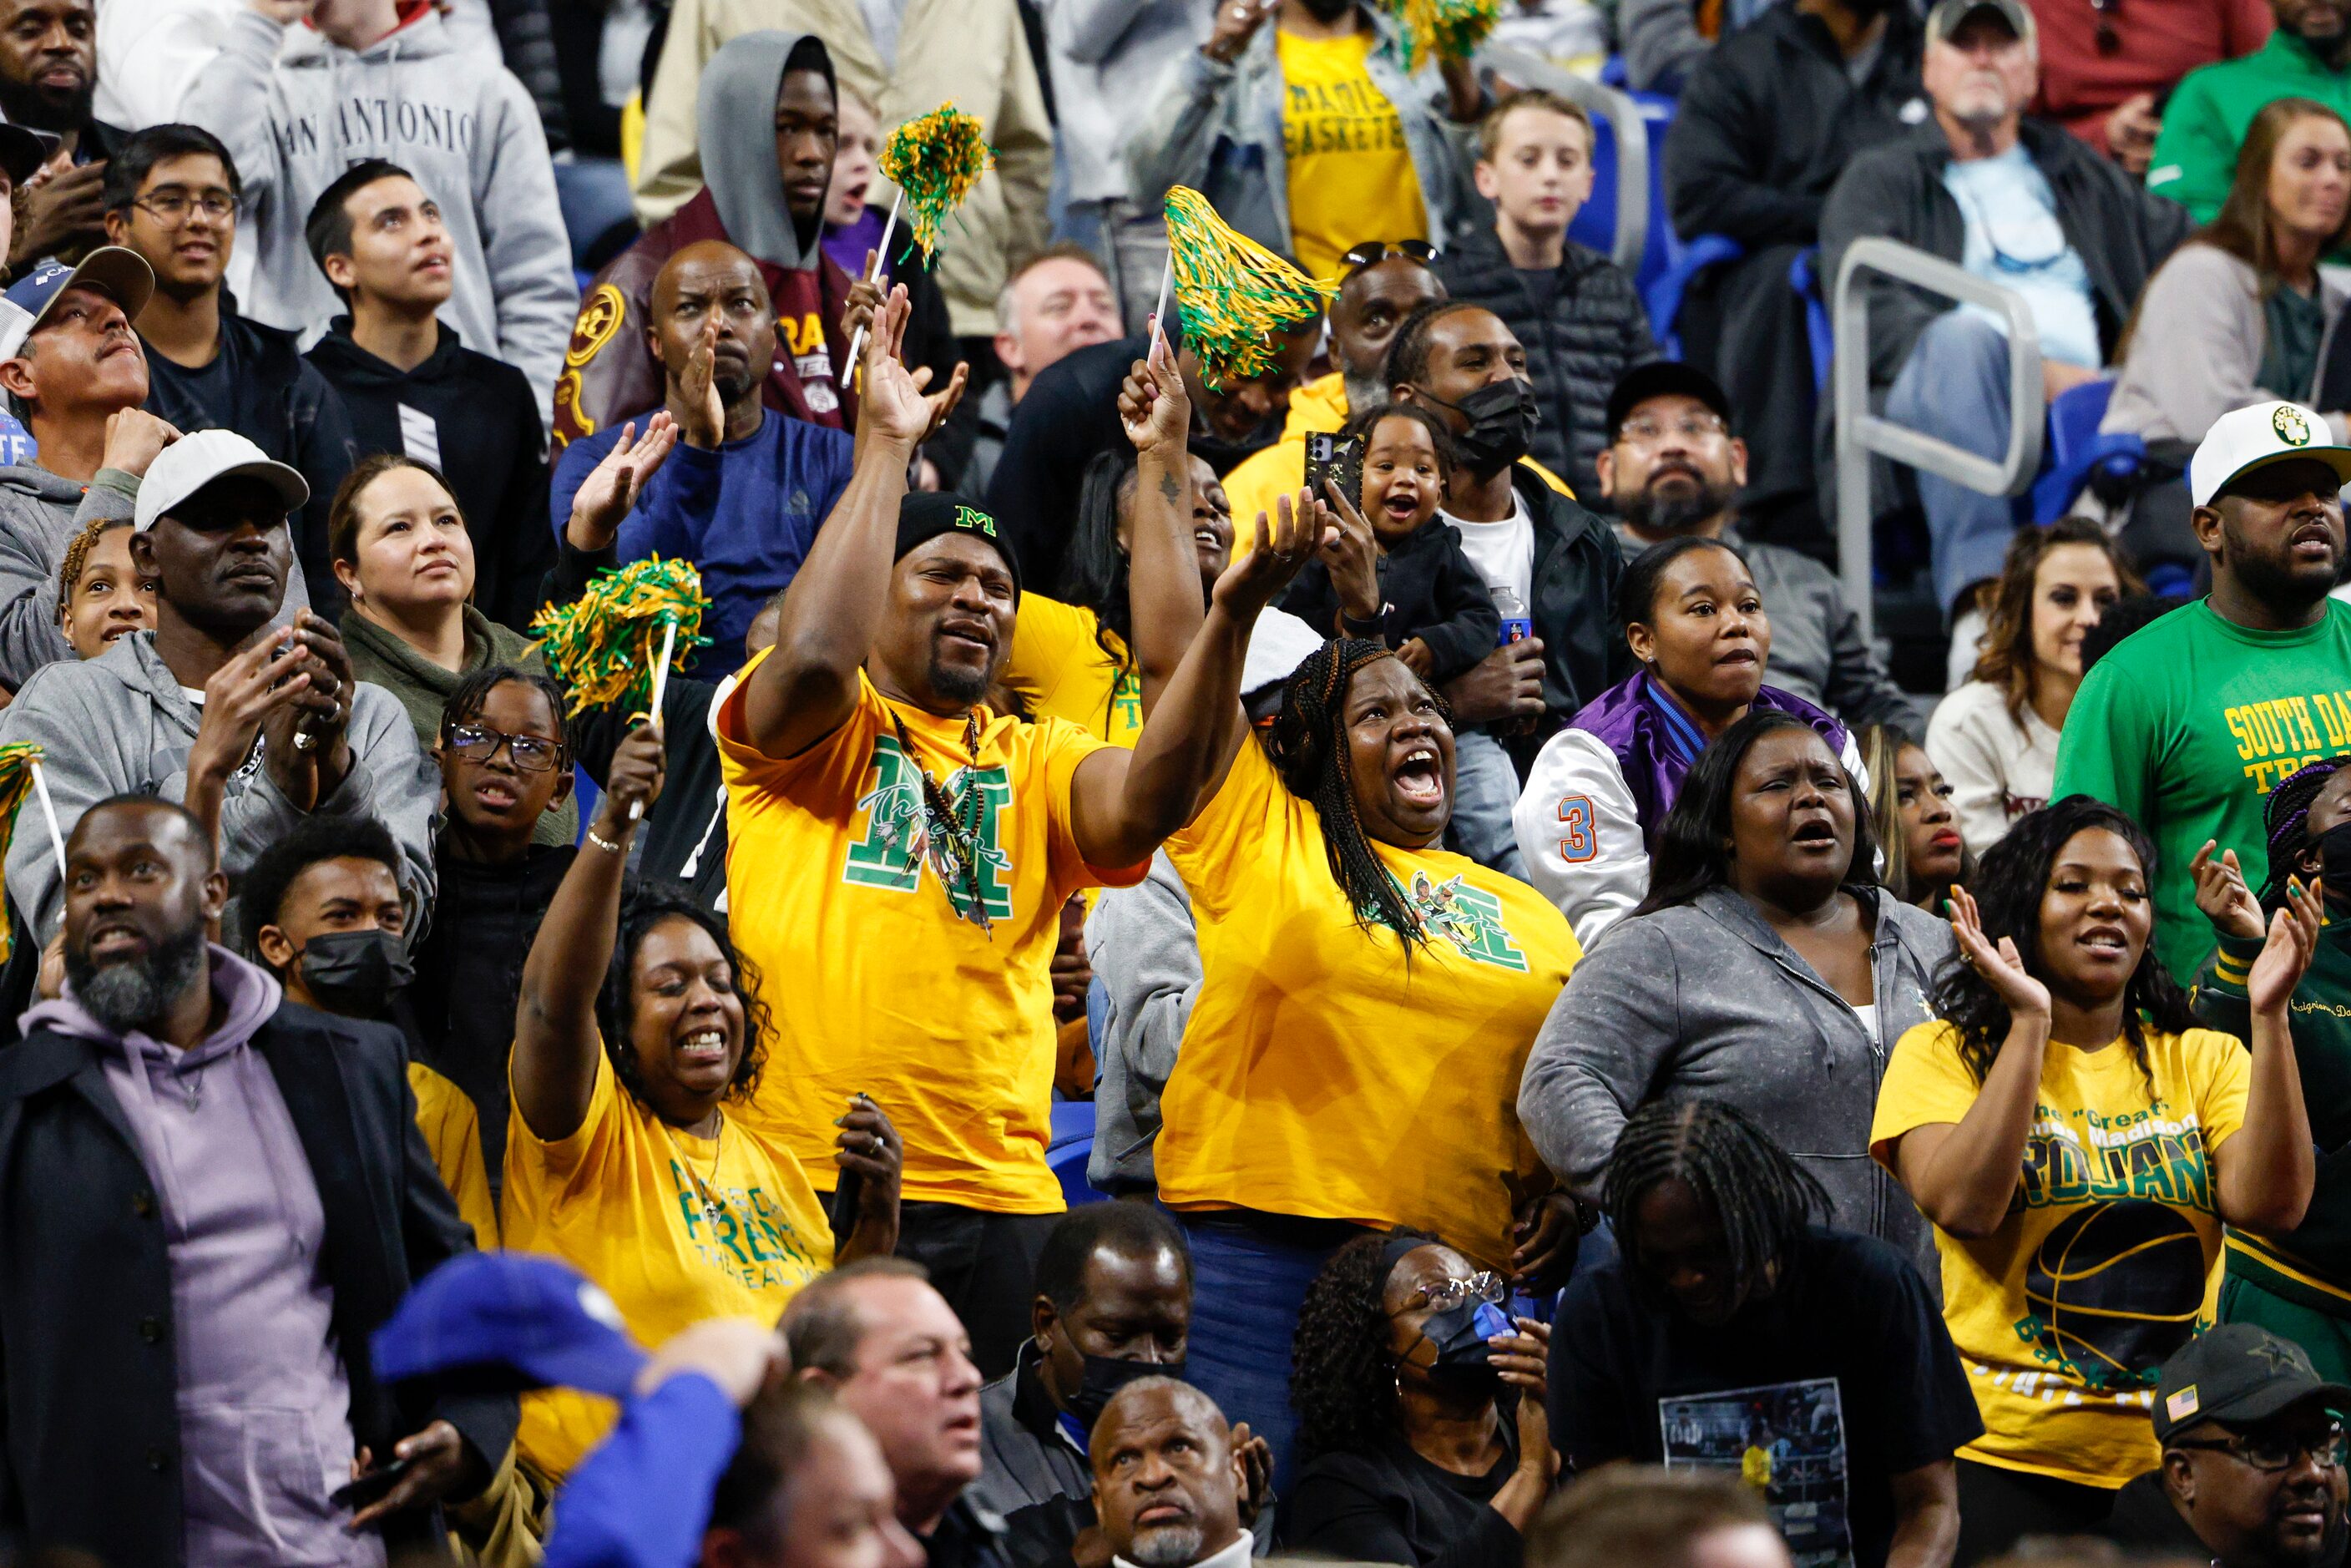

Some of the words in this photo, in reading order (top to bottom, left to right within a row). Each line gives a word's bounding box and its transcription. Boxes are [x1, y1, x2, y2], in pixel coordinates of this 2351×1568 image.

[954, 504, 997, 538] M
[2224, 695, 2323, 761] SOUTH
[1558, 796, 1598, 864] 3
[2088, 1113, 2198, 1147] Madison
